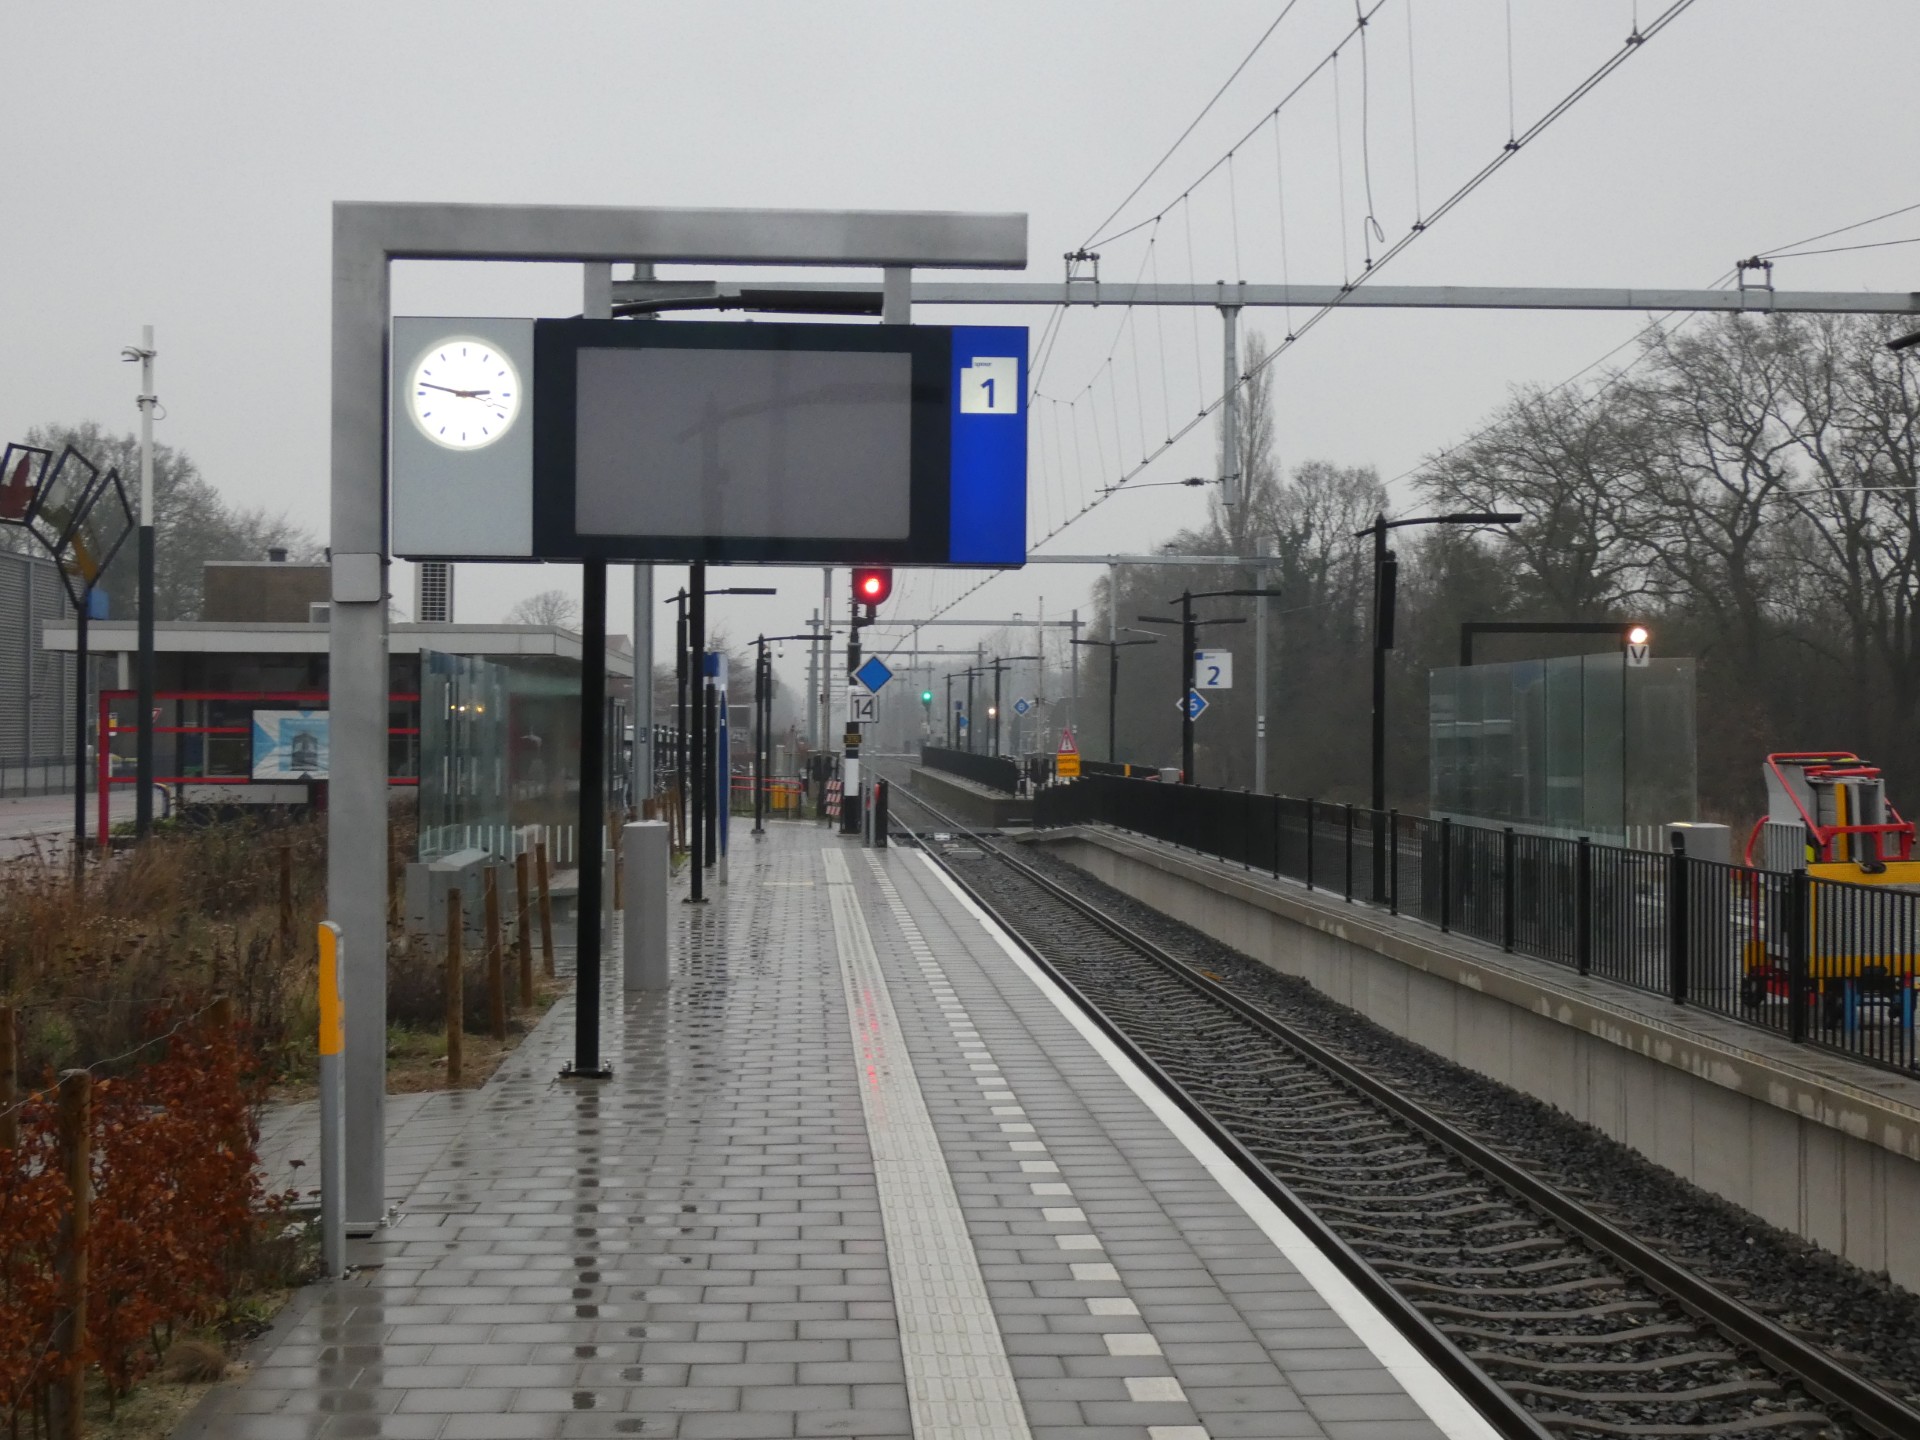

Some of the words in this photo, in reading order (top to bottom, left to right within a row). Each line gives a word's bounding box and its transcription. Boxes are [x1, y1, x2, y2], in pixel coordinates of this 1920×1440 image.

[980, 378, 995, 408] 1
[1630, 645, 1647, 665] V
[1207, 665, 1221, 686] 2
[854, 699, 873, 719] 14
